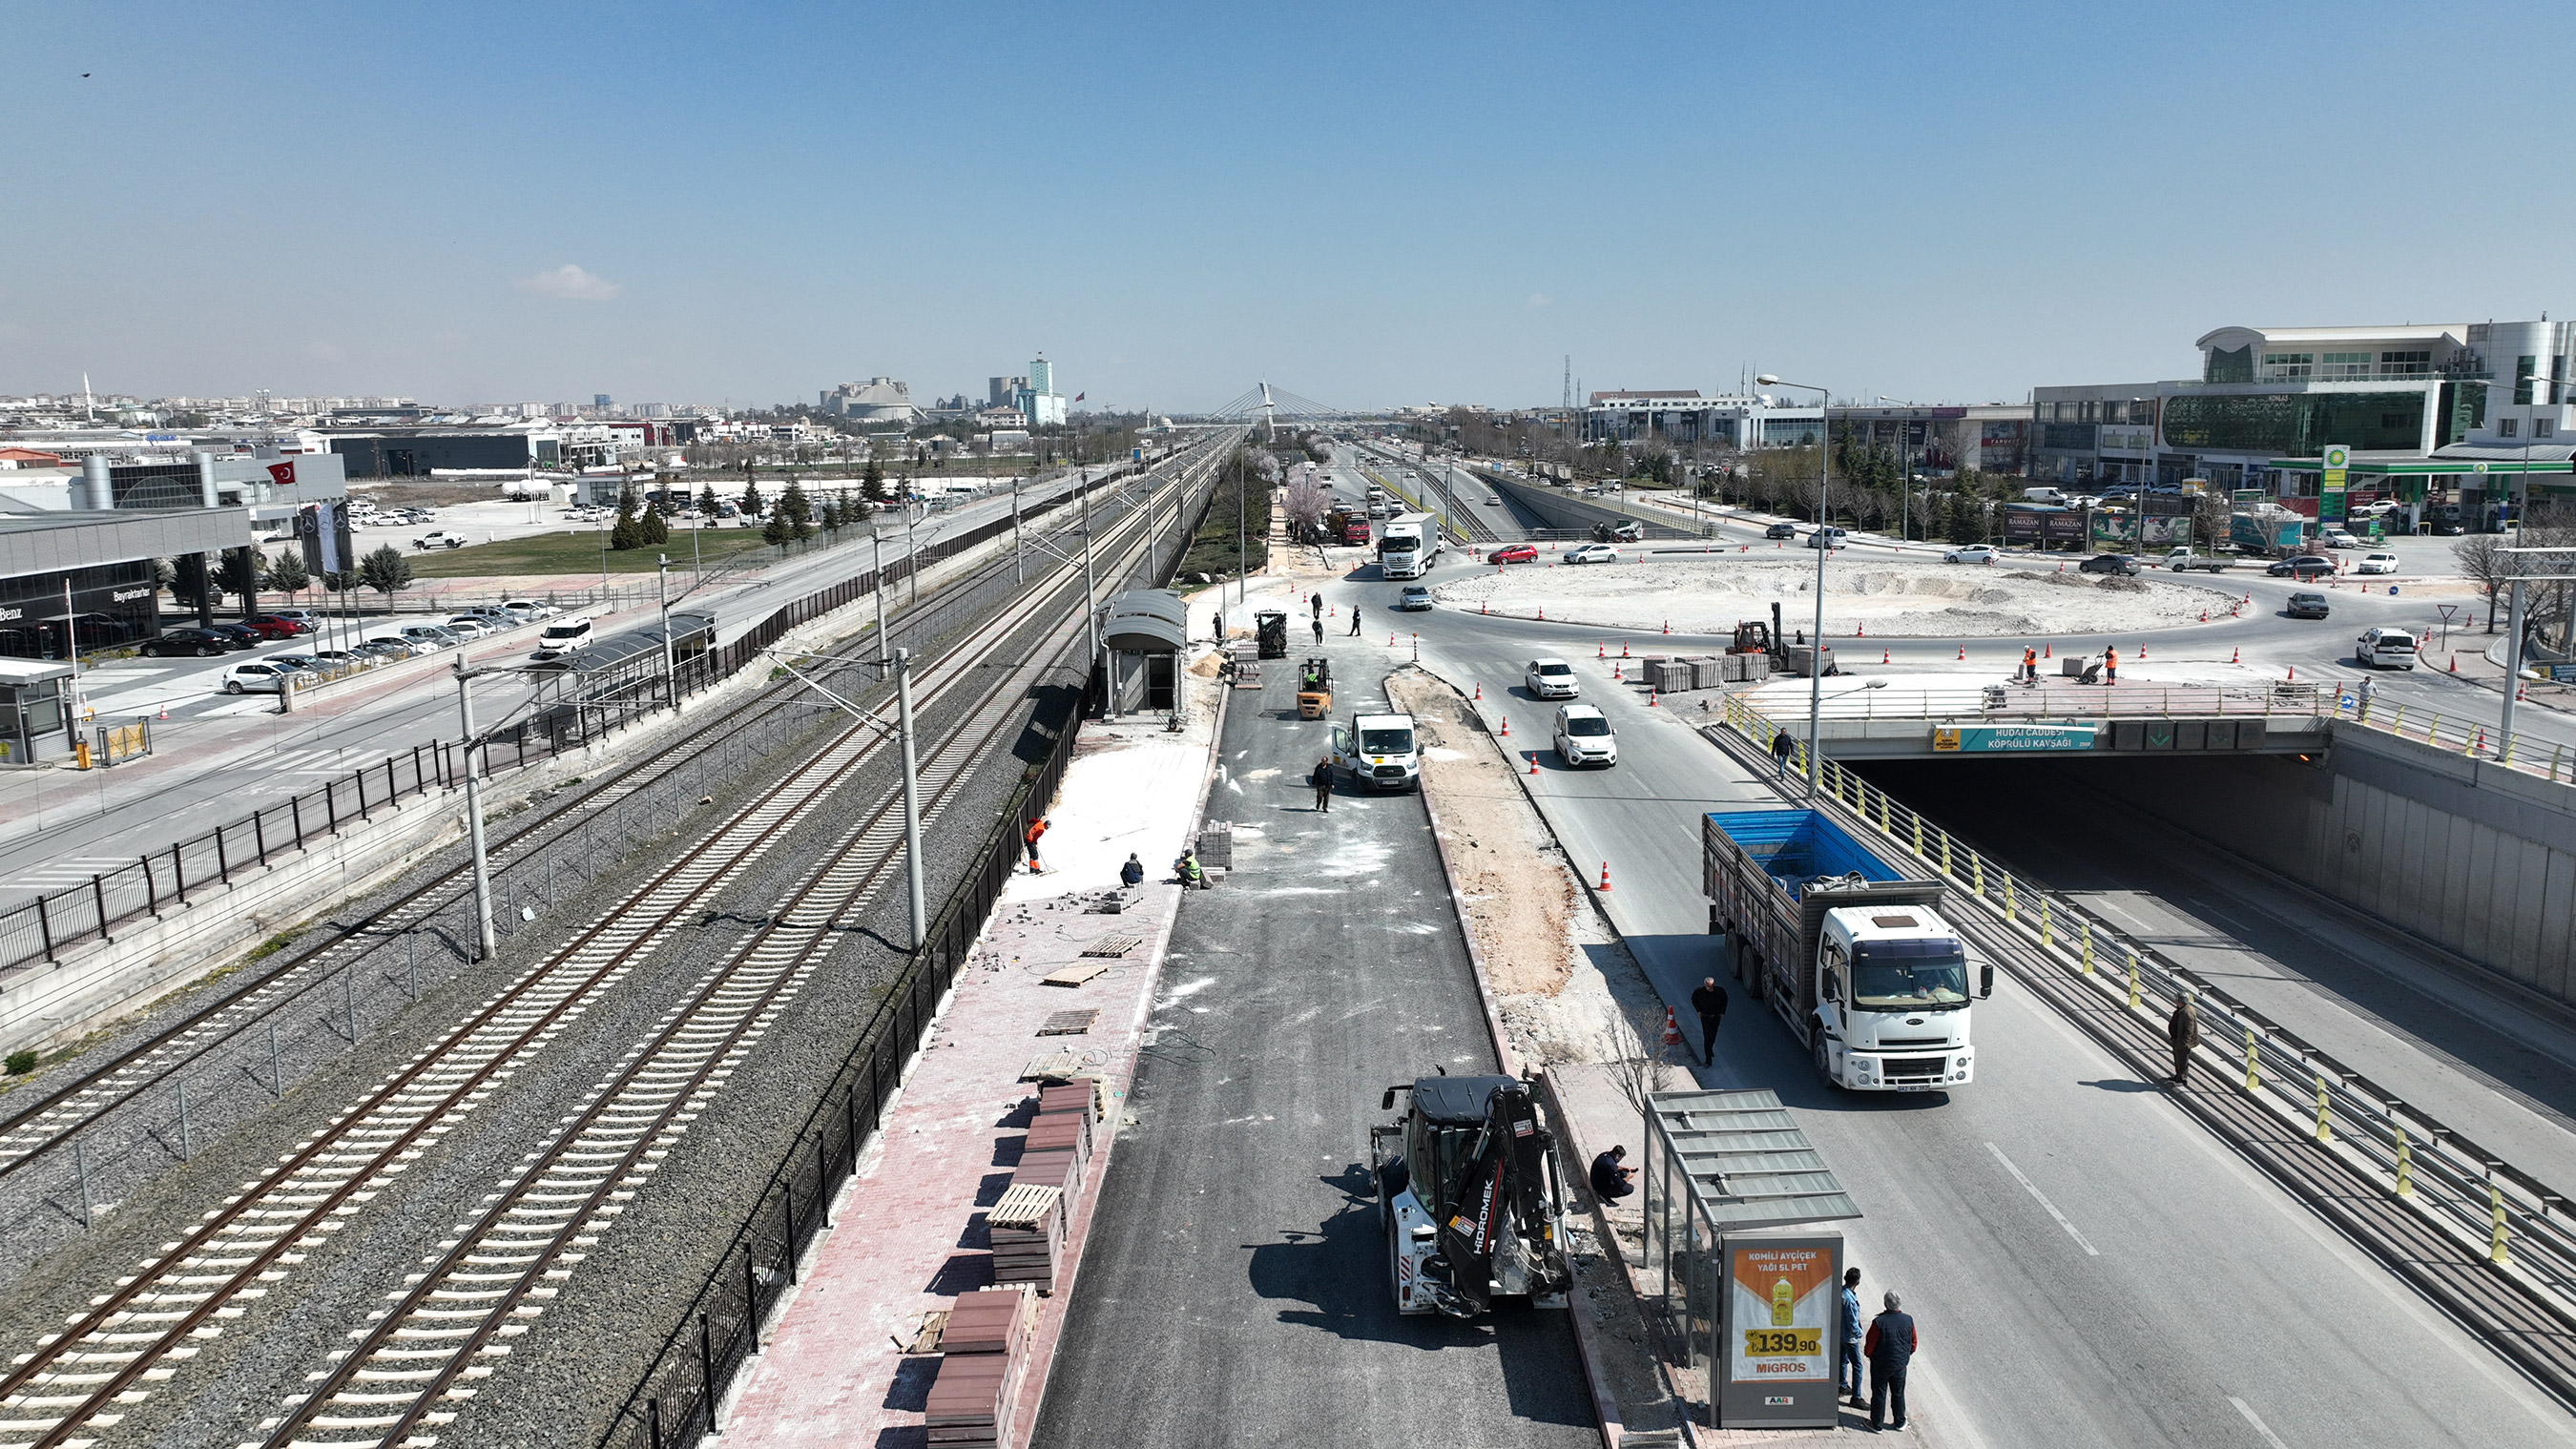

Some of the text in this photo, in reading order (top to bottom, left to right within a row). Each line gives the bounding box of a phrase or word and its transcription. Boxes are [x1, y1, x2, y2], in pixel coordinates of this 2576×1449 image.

[113, 587, 151, 603] Bayraktarlar
[1988, 737, 2071, 749] KÖPRÜLÜ KAVŞAĞI
[1749, 1251, 1817, 1261] KOMİLİ AYÇİÇEK
[1757, 1262, 1776, 1272] YAĞI
